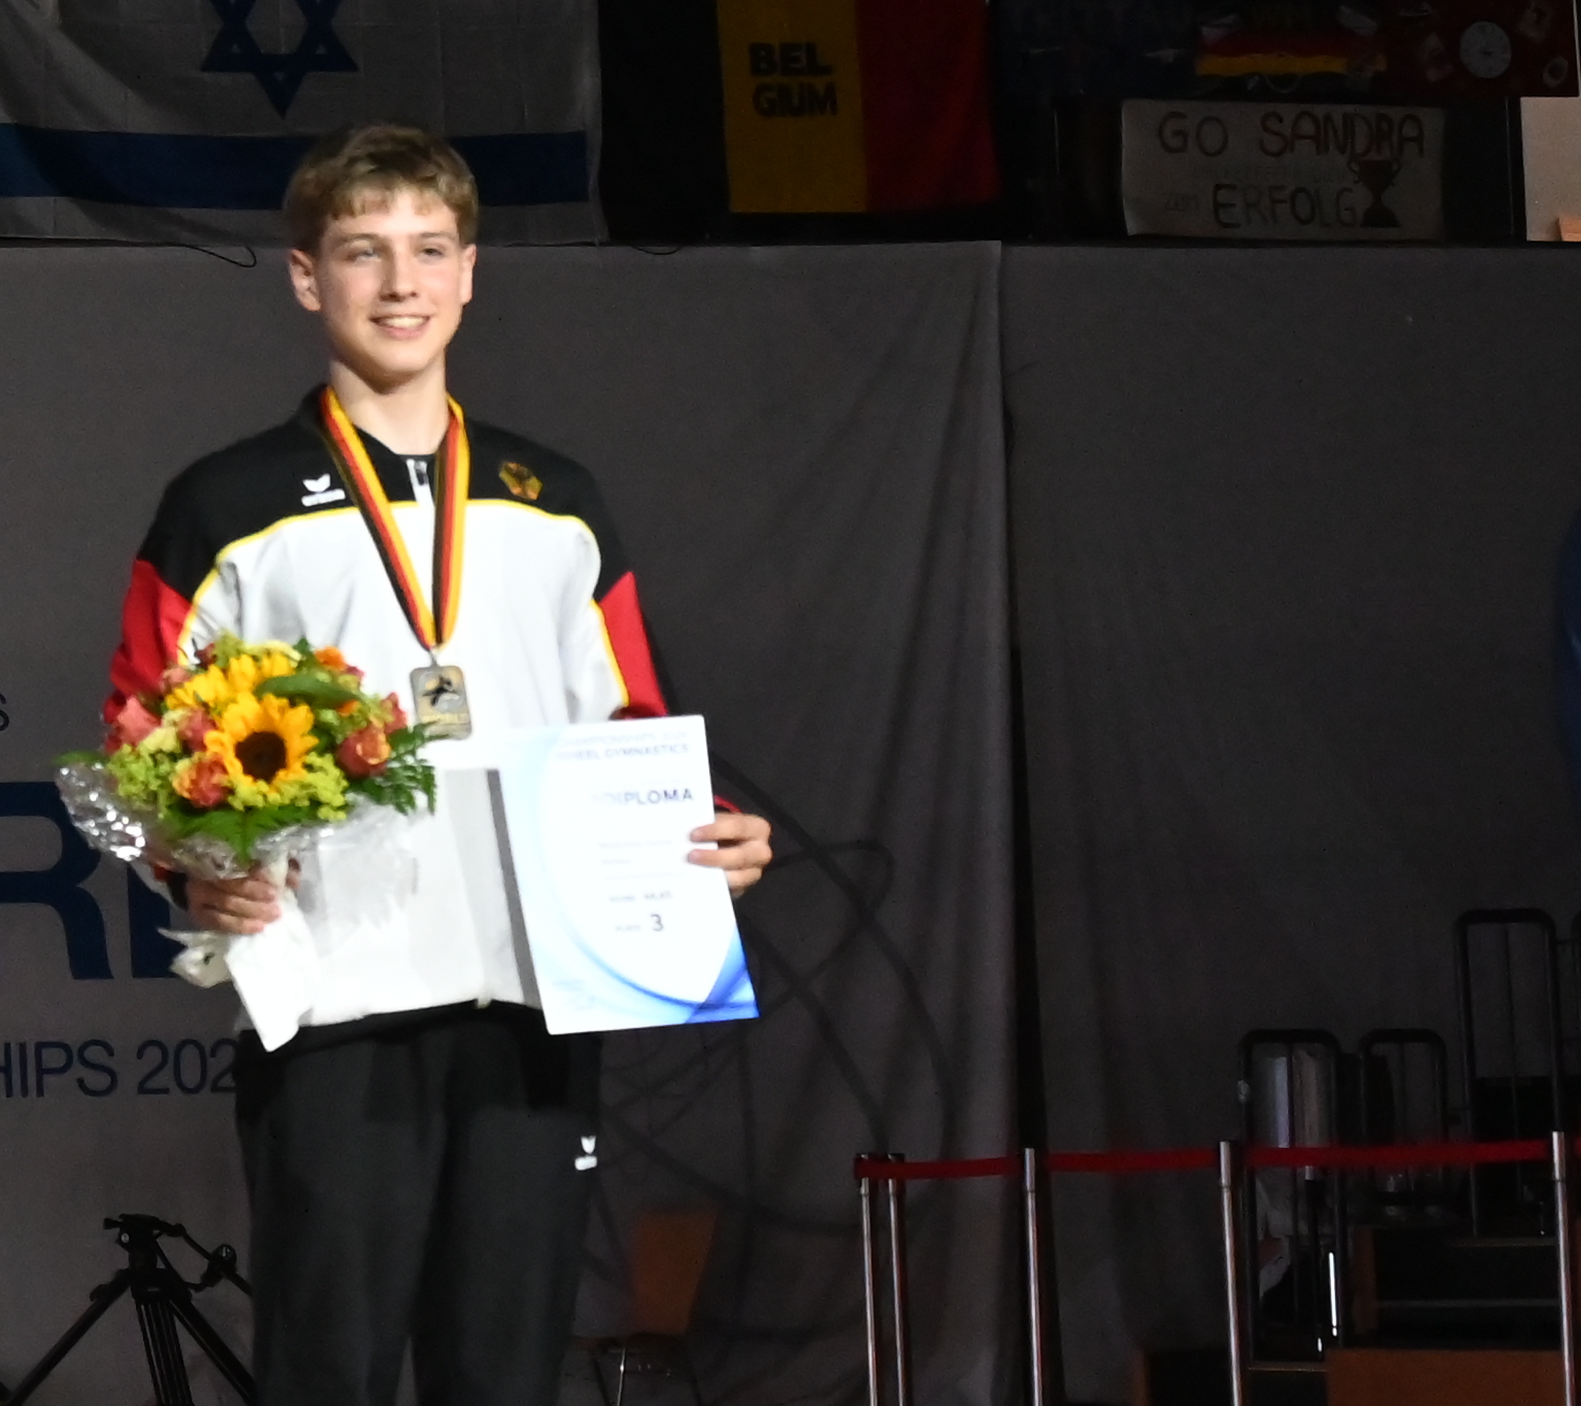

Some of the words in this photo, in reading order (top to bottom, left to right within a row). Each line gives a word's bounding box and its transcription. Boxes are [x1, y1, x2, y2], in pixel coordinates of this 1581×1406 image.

[749, 42, 833, 76] BEL
[753, 81, 840, 119] GIUM
[1158, 111, 1229, 157] GO
[1258, 110, 1425, 159] SANDRA
[1212, 182, 1357, 230] ERFOLG
[646, 909, 667, 934] 3
